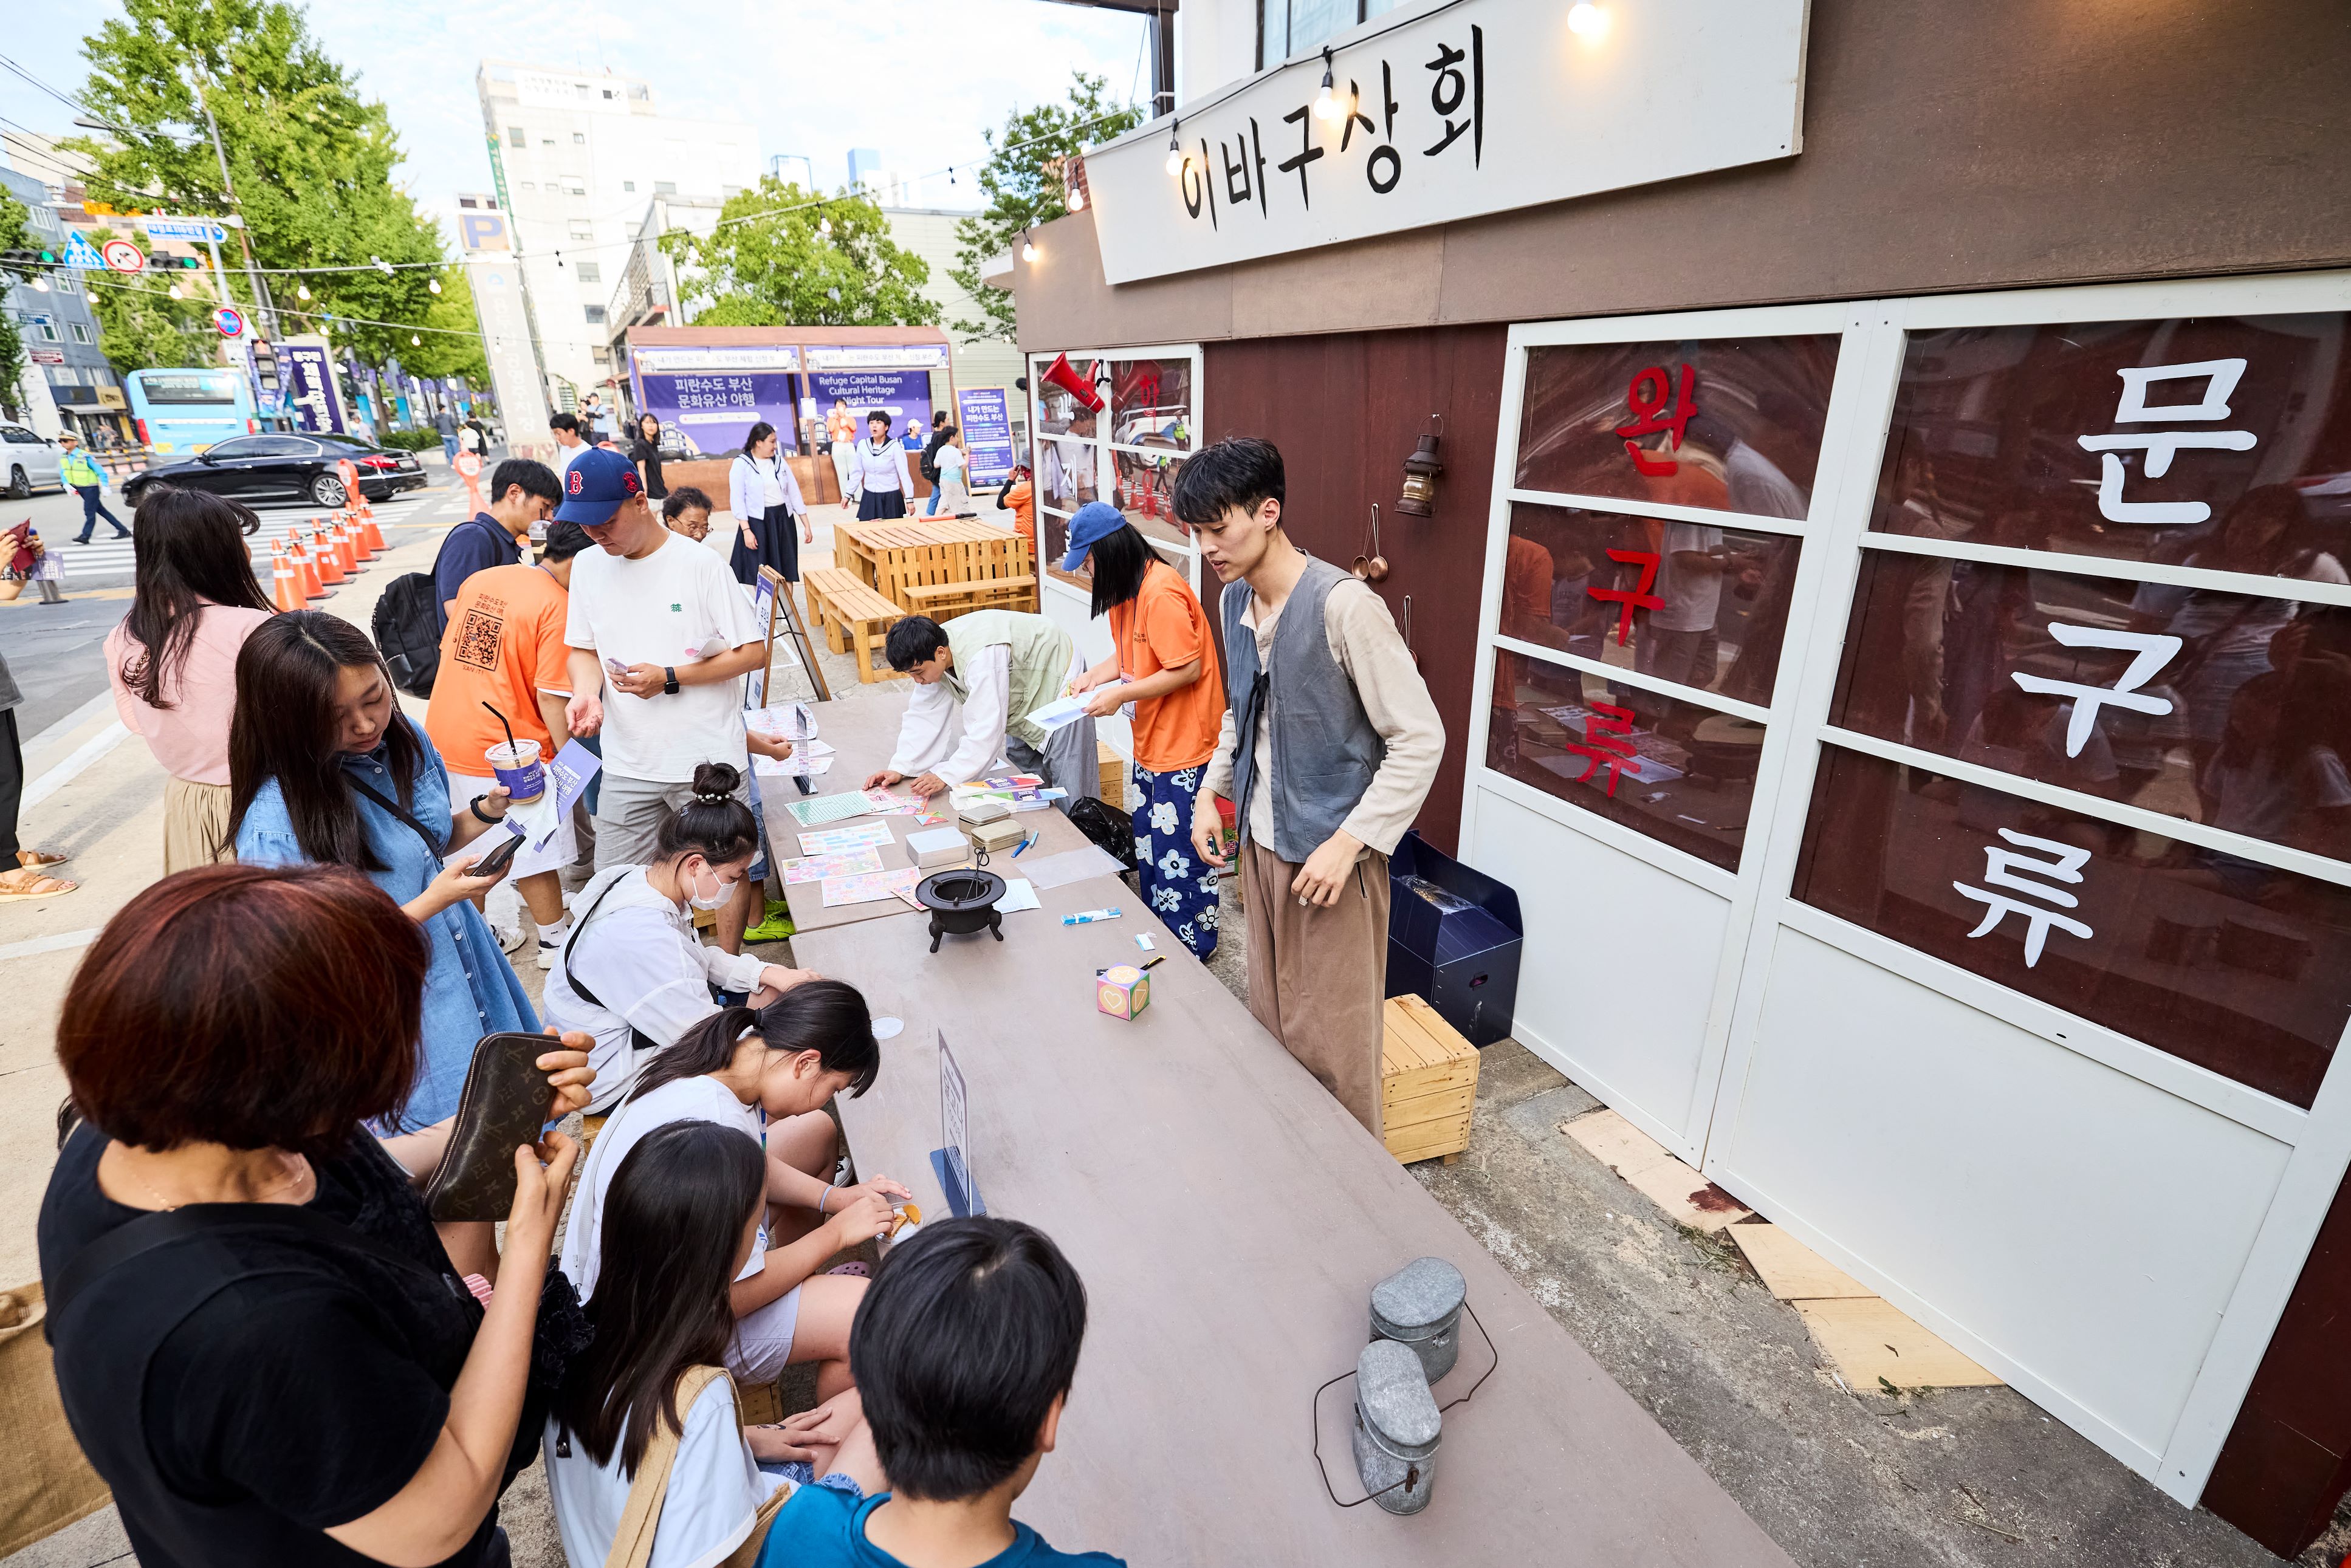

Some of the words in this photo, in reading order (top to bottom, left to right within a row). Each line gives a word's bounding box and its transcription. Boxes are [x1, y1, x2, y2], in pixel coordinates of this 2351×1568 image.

[1181, 24, 1483, 233] 이바구상회
[462, 215, 503, 248] P
[675, 378, 726, 394] 피란수도
[728, 377, 753, 391] 부산
[819, 376, 848, 386] Refuge
[849, 375, 877, 385] Capital
[879, 375, 902, 384] Busan
[829, 386, 860, 395] Cultural
[862, 386, 895, 395] Heritage
[678, 394, 727, 409] 문화유산
[730, 392, 755, 407] 야행
[843, 396, 865, 406] Night
[867, 396, 885, 405] Tour
[981, 405, 1000, 413] 만드는
[966, 414, 990, 422] 피란수도
[568, 471, 584, 495] B
[1567, 365, 1697, 798] 완구류
[1952, 358, 2257, 968] 문구류
[552, 764, 569, 781] 피란수도
[567, 776, 578, 788] 부산
[561, 784, 574, 796] 야행
